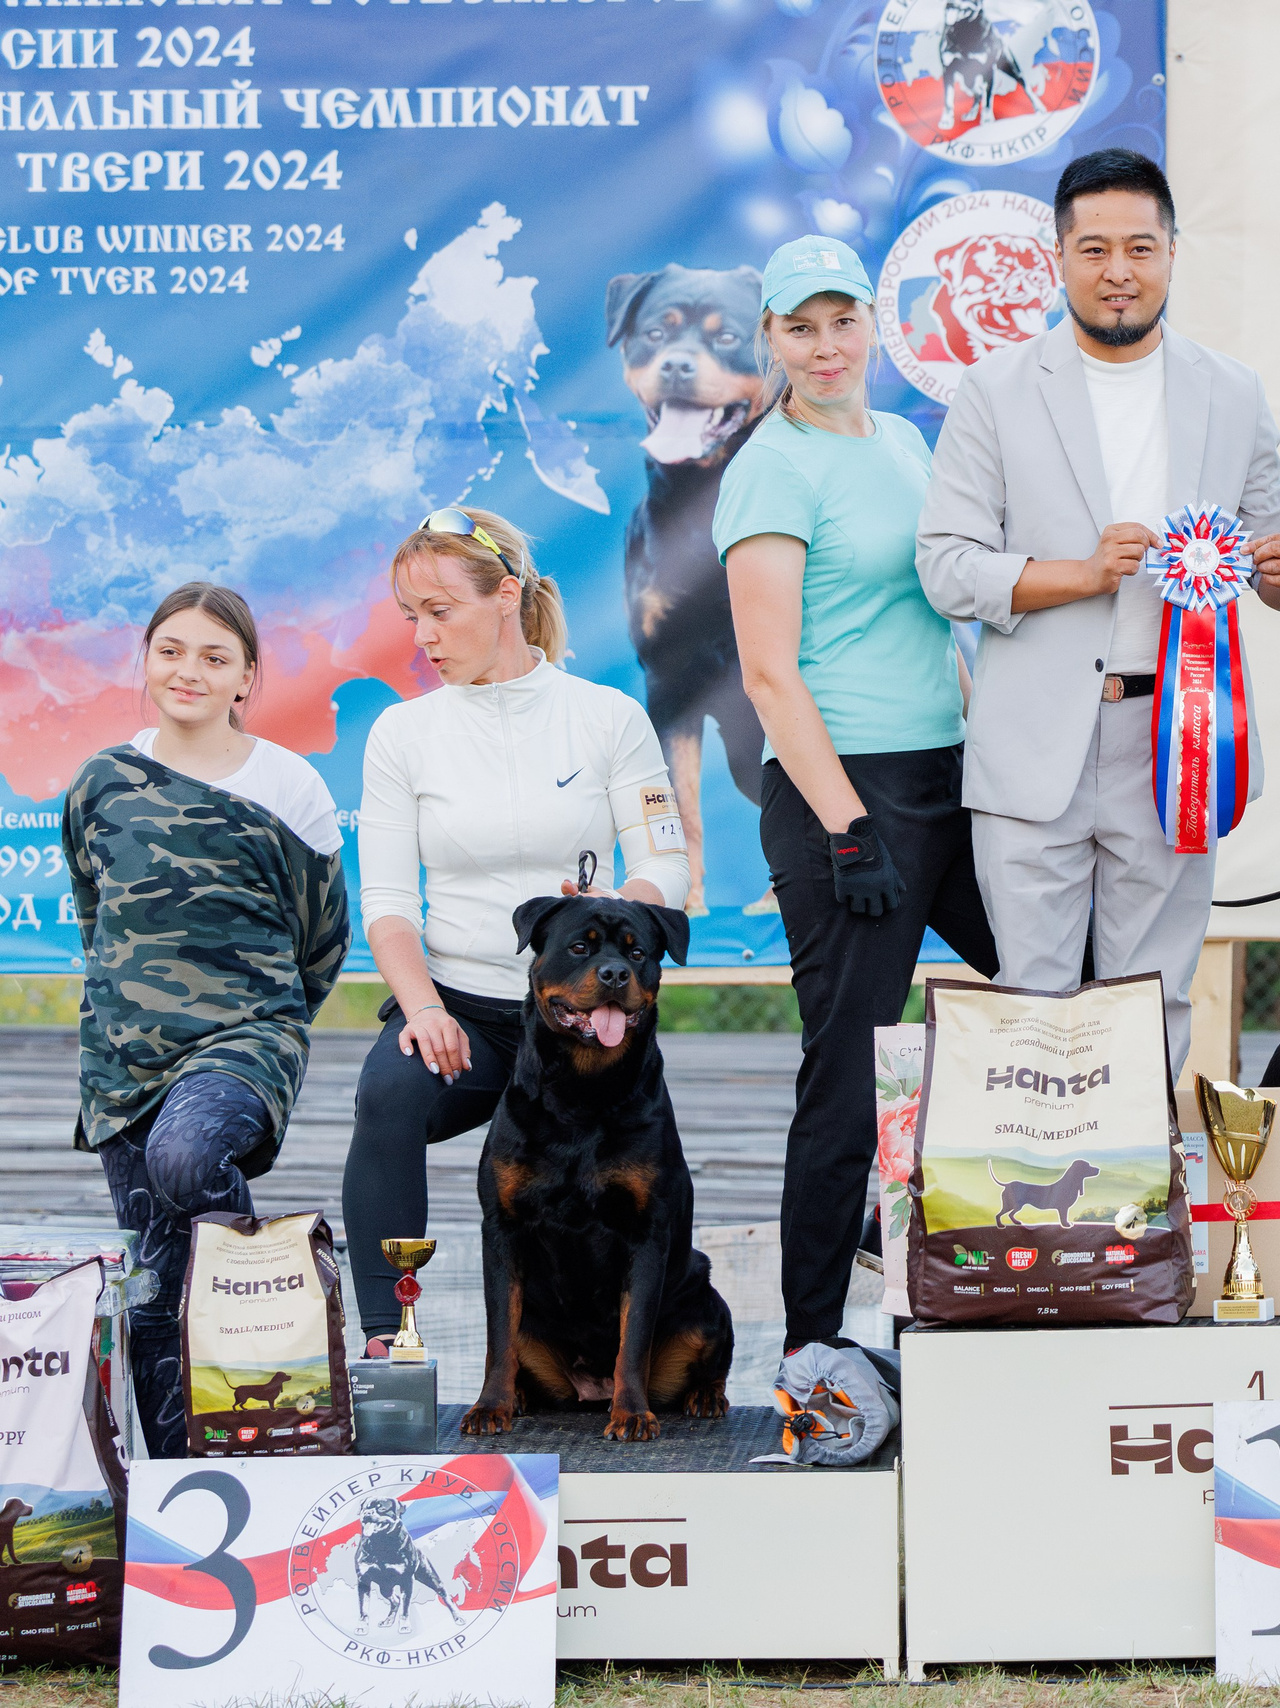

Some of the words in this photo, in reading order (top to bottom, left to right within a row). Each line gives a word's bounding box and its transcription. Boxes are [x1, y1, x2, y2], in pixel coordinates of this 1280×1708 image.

[136, 26, 256, 68] 2024
[281, 85, 650, 130] ЧЕМПИОНАТ
[931, 126, 1050, 162] РКФ-НКПР
[17, 150, 204, 193] ТВЕРИ
[223, 149, 343, 191] 2024
[97, 224, 254, 253] WINNER
[266, 223, 346, 252] 2024
[881, 213, 941, 291] РОССИИ
[942, 194, 991, 220] 2024
[52, 266, 157, 295] TVER
[170, 266, 249, 294] 2024
[1185, 756, 1201, 839] Победитель
[1193, 704, 1202, 750] класса
[1000, 1018, 1020, 1026] Корм
[1015, 1038, 1058, 1055] говядиной
[1066, 1044, 1093, 1059] рисом
[986, 1064, 1110, 1097] Hanta
[1024, 1096, 1075, 1111] premium
[994, 1120, 1099, 1141] SMALL/MEDIUM
[1011, 1251, 1032, 1259] FRESH
[1012, 1259, 1029, 1267] MEAT
[212, 1273, 305, 1295] Hanta
[8, 1311, 42, 1324] рисом
[219, 1321, 294, 1334] SMALL/MEDIUM
[291, 1470, 384, 1616] РОТВЕЙЛЕР
[399, 1467, 475, 1501] КЛУБ
[479, 1503, 515, 1614] РОССИИ
[148, 1470, 256, 1669] 3
[342, 1634, 468, 1667] РКФ-НКПР
